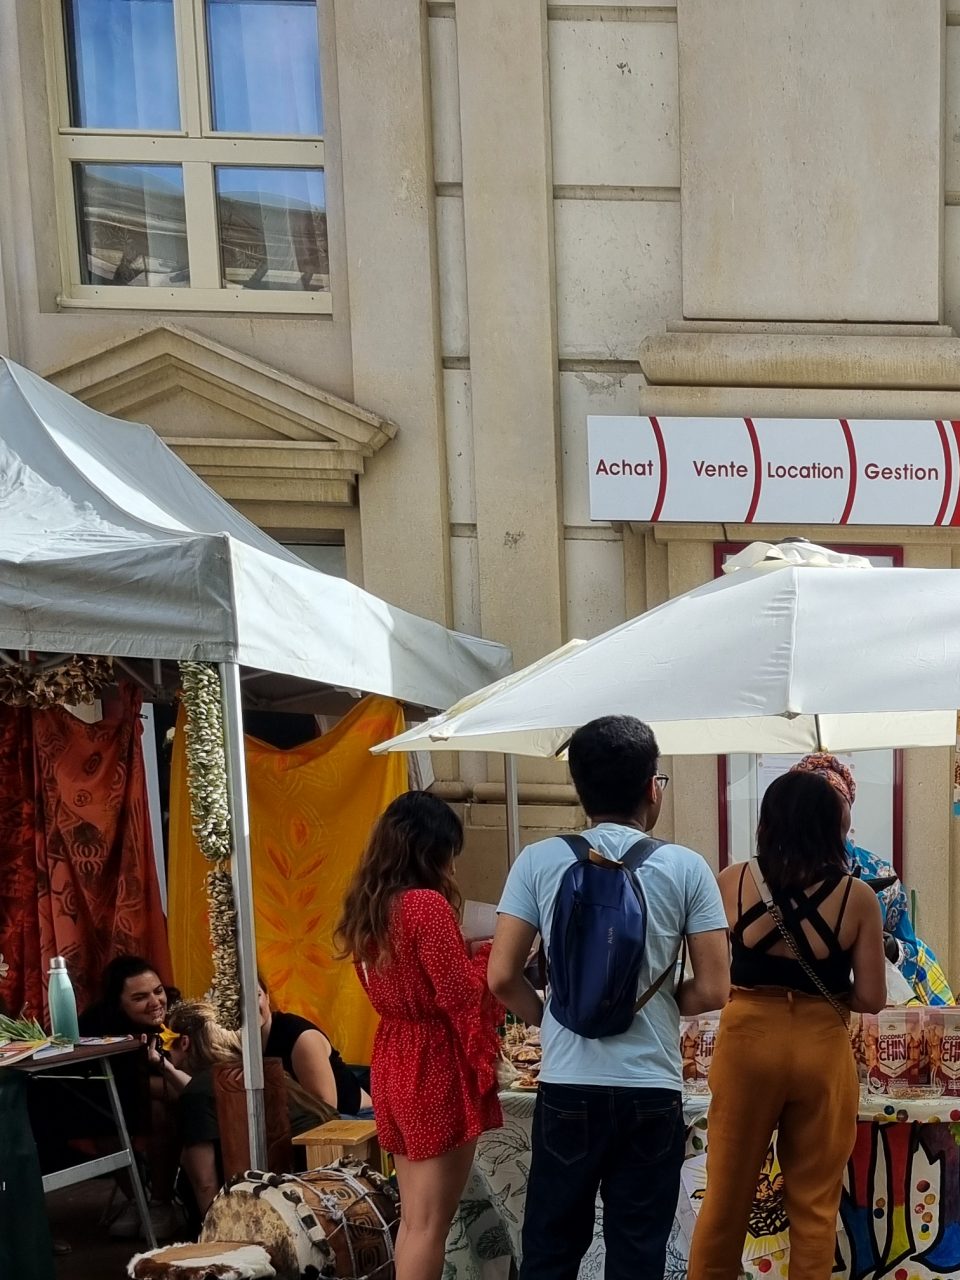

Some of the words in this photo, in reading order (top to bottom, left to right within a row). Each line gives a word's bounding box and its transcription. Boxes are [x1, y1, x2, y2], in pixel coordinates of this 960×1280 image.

[596, 459, 653, 477] Achat
[693, 460, 748, 478] Vente
[767, 461, 844, 480] Location
[864, 462, 939, 480] Gestion
[879, 1040, 907, 1051] CHIN
[880, 1033, 907, 1041] COCONUT
[879, 1050, 907, 1062] CHIN
